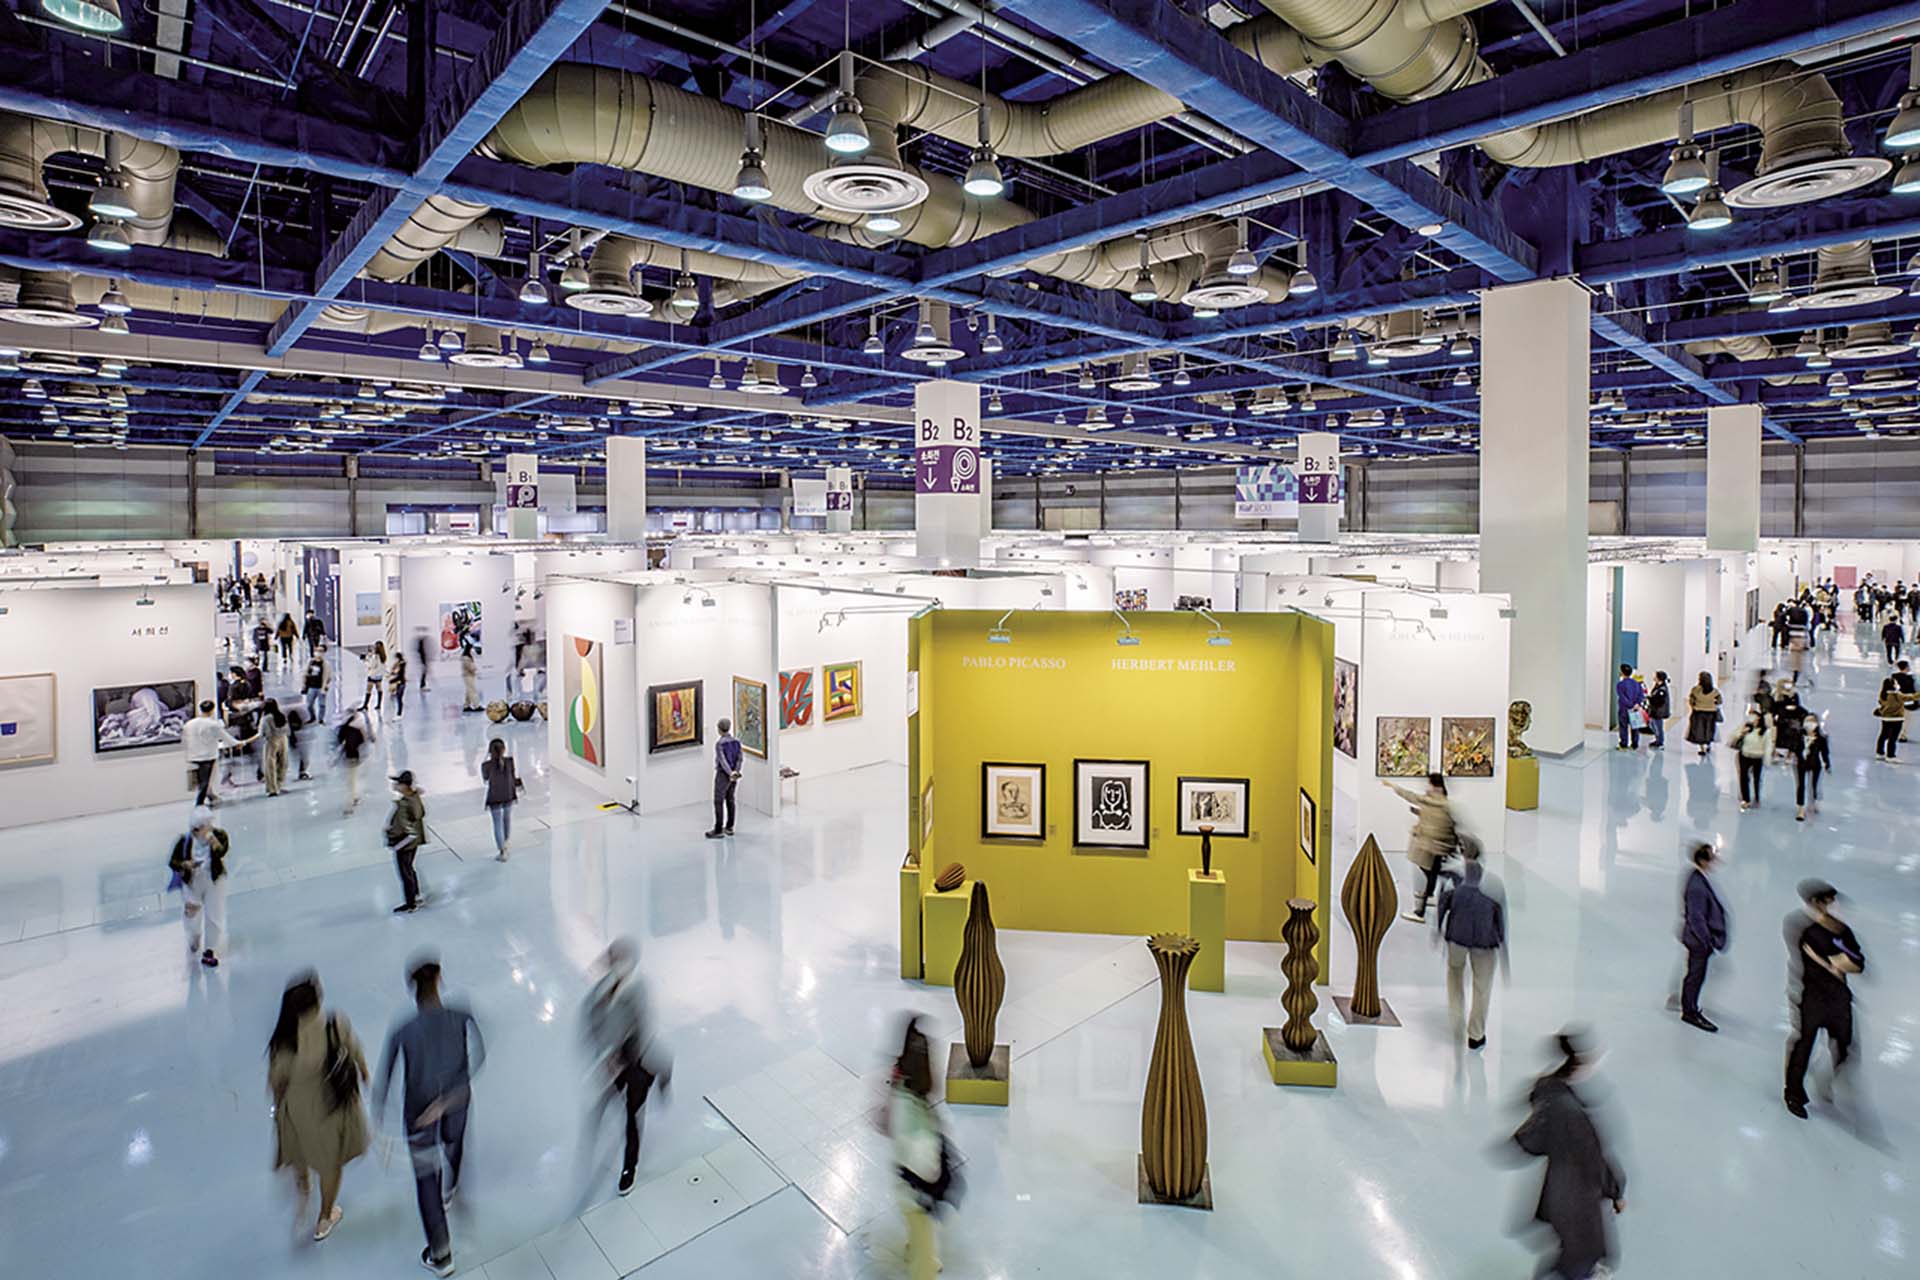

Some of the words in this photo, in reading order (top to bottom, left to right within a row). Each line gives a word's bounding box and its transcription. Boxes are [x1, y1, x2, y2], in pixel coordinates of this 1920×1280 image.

[922, 418, 940, 441] B2
[953, 417, 973, 441] B2
[1304, 457, 1320, 471] B2
[962, 655, 1006, 669] PABLO
[1008, 656, 1067, 670] PICASSO
[1111, 658, 1174, 671] HERBERT
[1177, 659, 1237, 672] MEHLER
